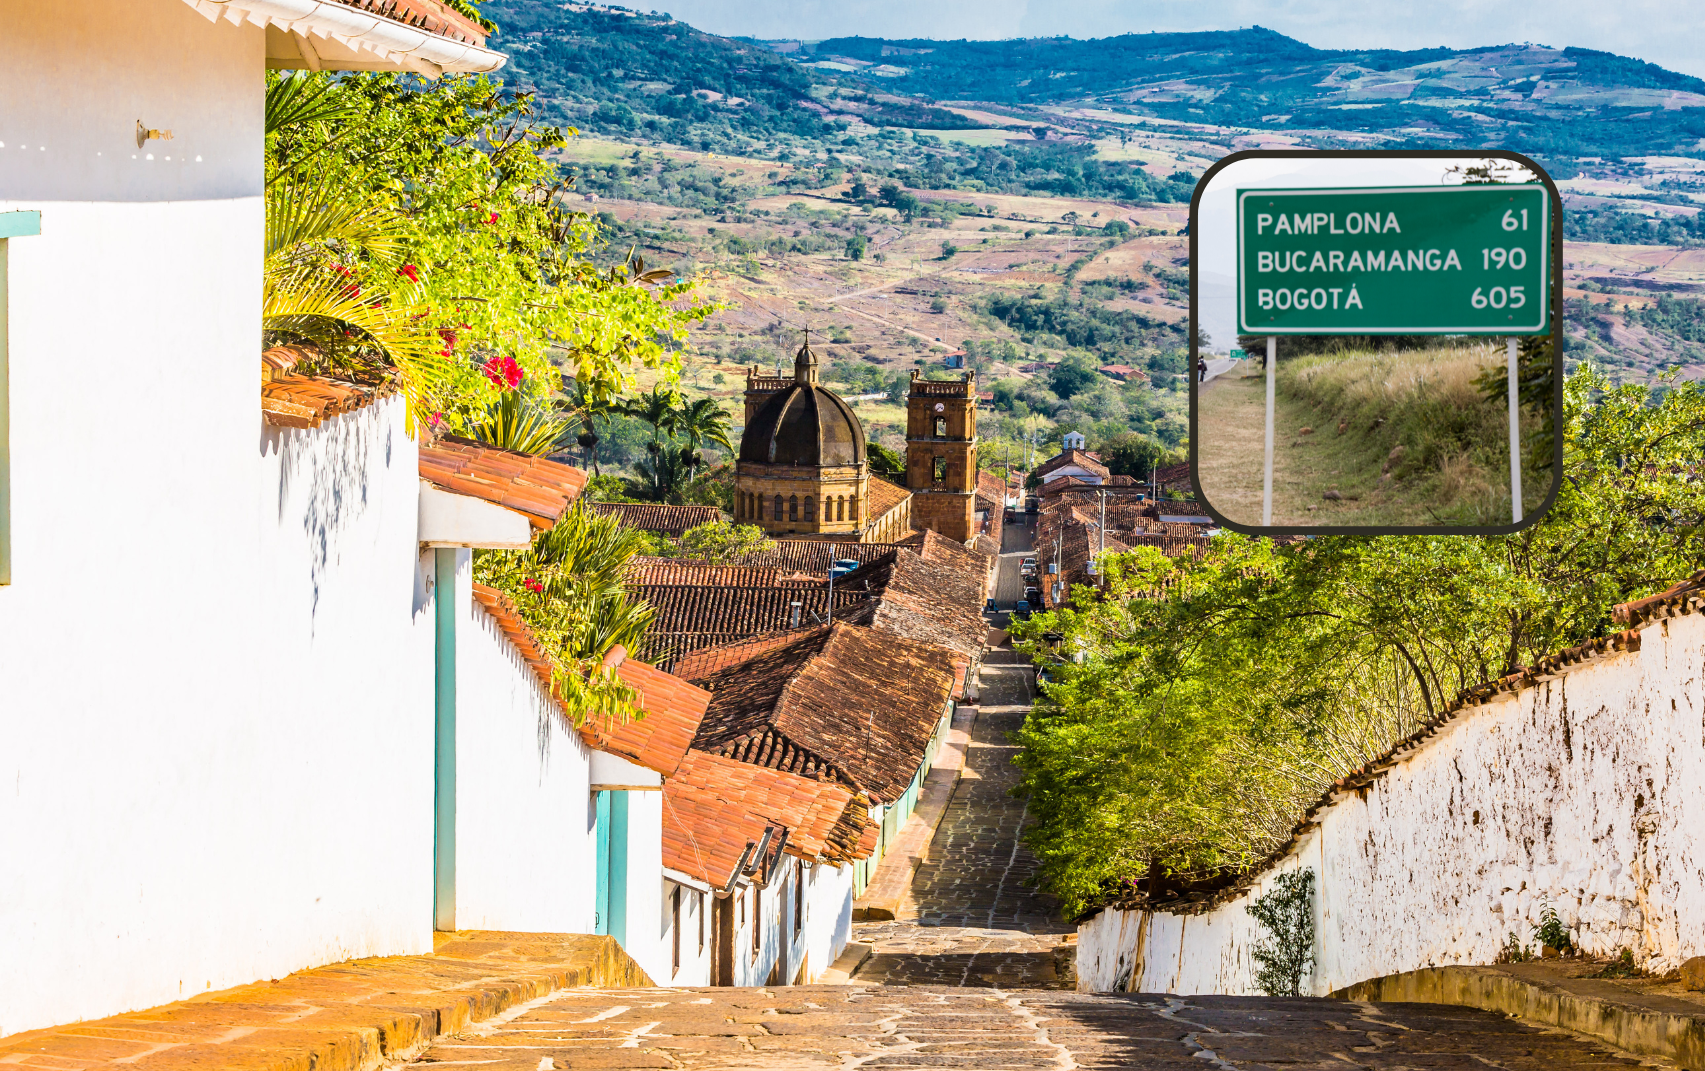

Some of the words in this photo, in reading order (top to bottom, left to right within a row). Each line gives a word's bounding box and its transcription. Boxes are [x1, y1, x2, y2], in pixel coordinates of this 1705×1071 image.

[1257, 212, 1401, 235] PAMPLONA
[1501, 208, 1528, 232] 61
[1257, 248, 1462, 273] BUCARAMANGA
[1482, 247, 1527, 271] 190
[1258, 283, 1363, 310] BOGOTÁ
[1471, 286, 1526, 309] 605
